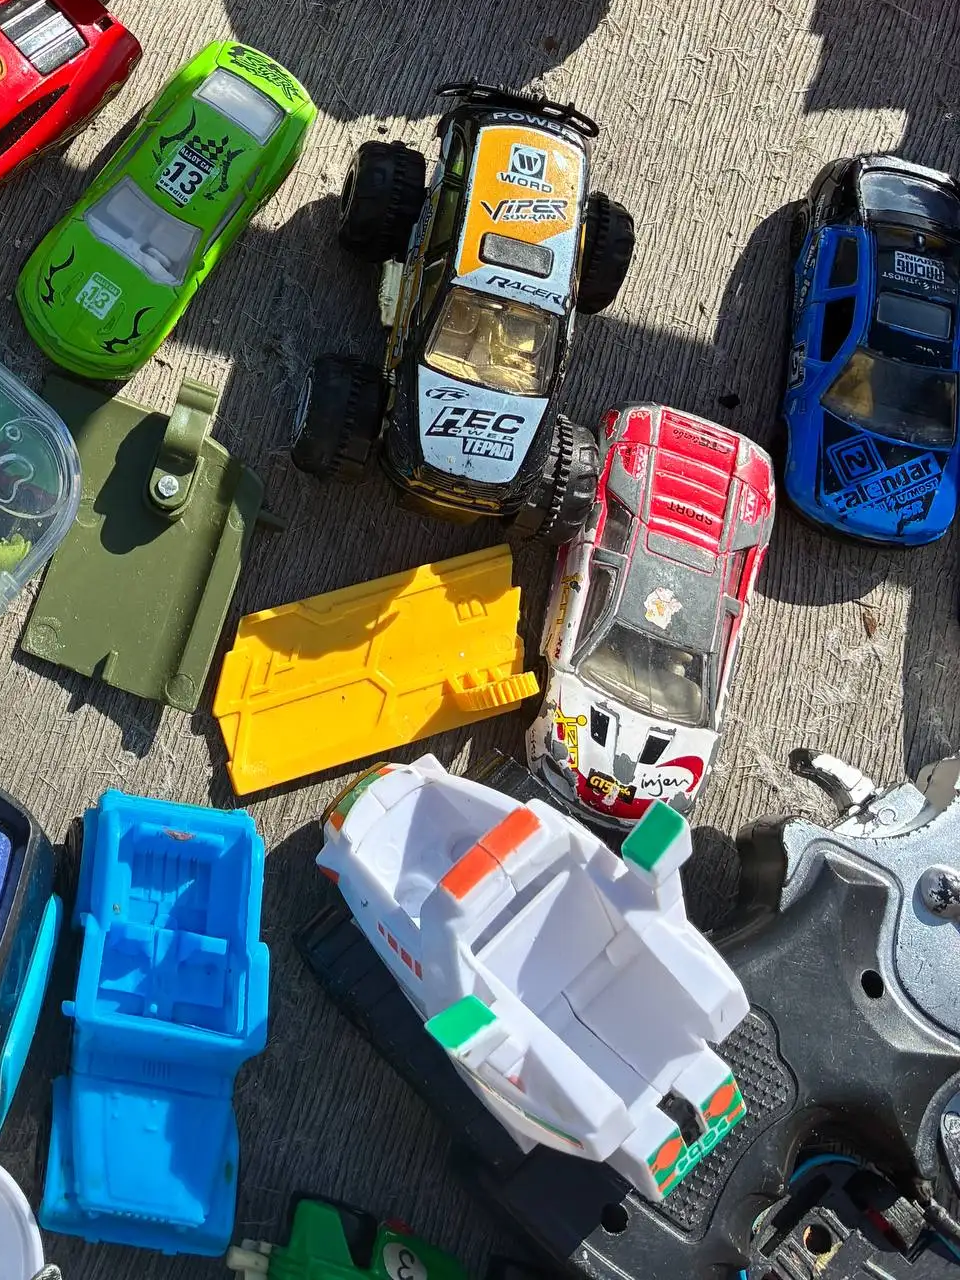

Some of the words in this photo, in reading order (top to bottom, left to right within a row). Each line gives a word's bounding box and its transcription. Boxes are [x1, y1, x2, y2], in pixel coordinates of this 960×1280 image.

[179, 146, 201, 165] ALLOY
[167, 160, 204, 196] 13
[500, 172, 553, 194] WORD
[896, 259, 944, 283] RACING
[486, 275, 563, 304] RACER
[463, 438, 513, 460] TEPAR
[667, 500, 714, 526] SPORT
